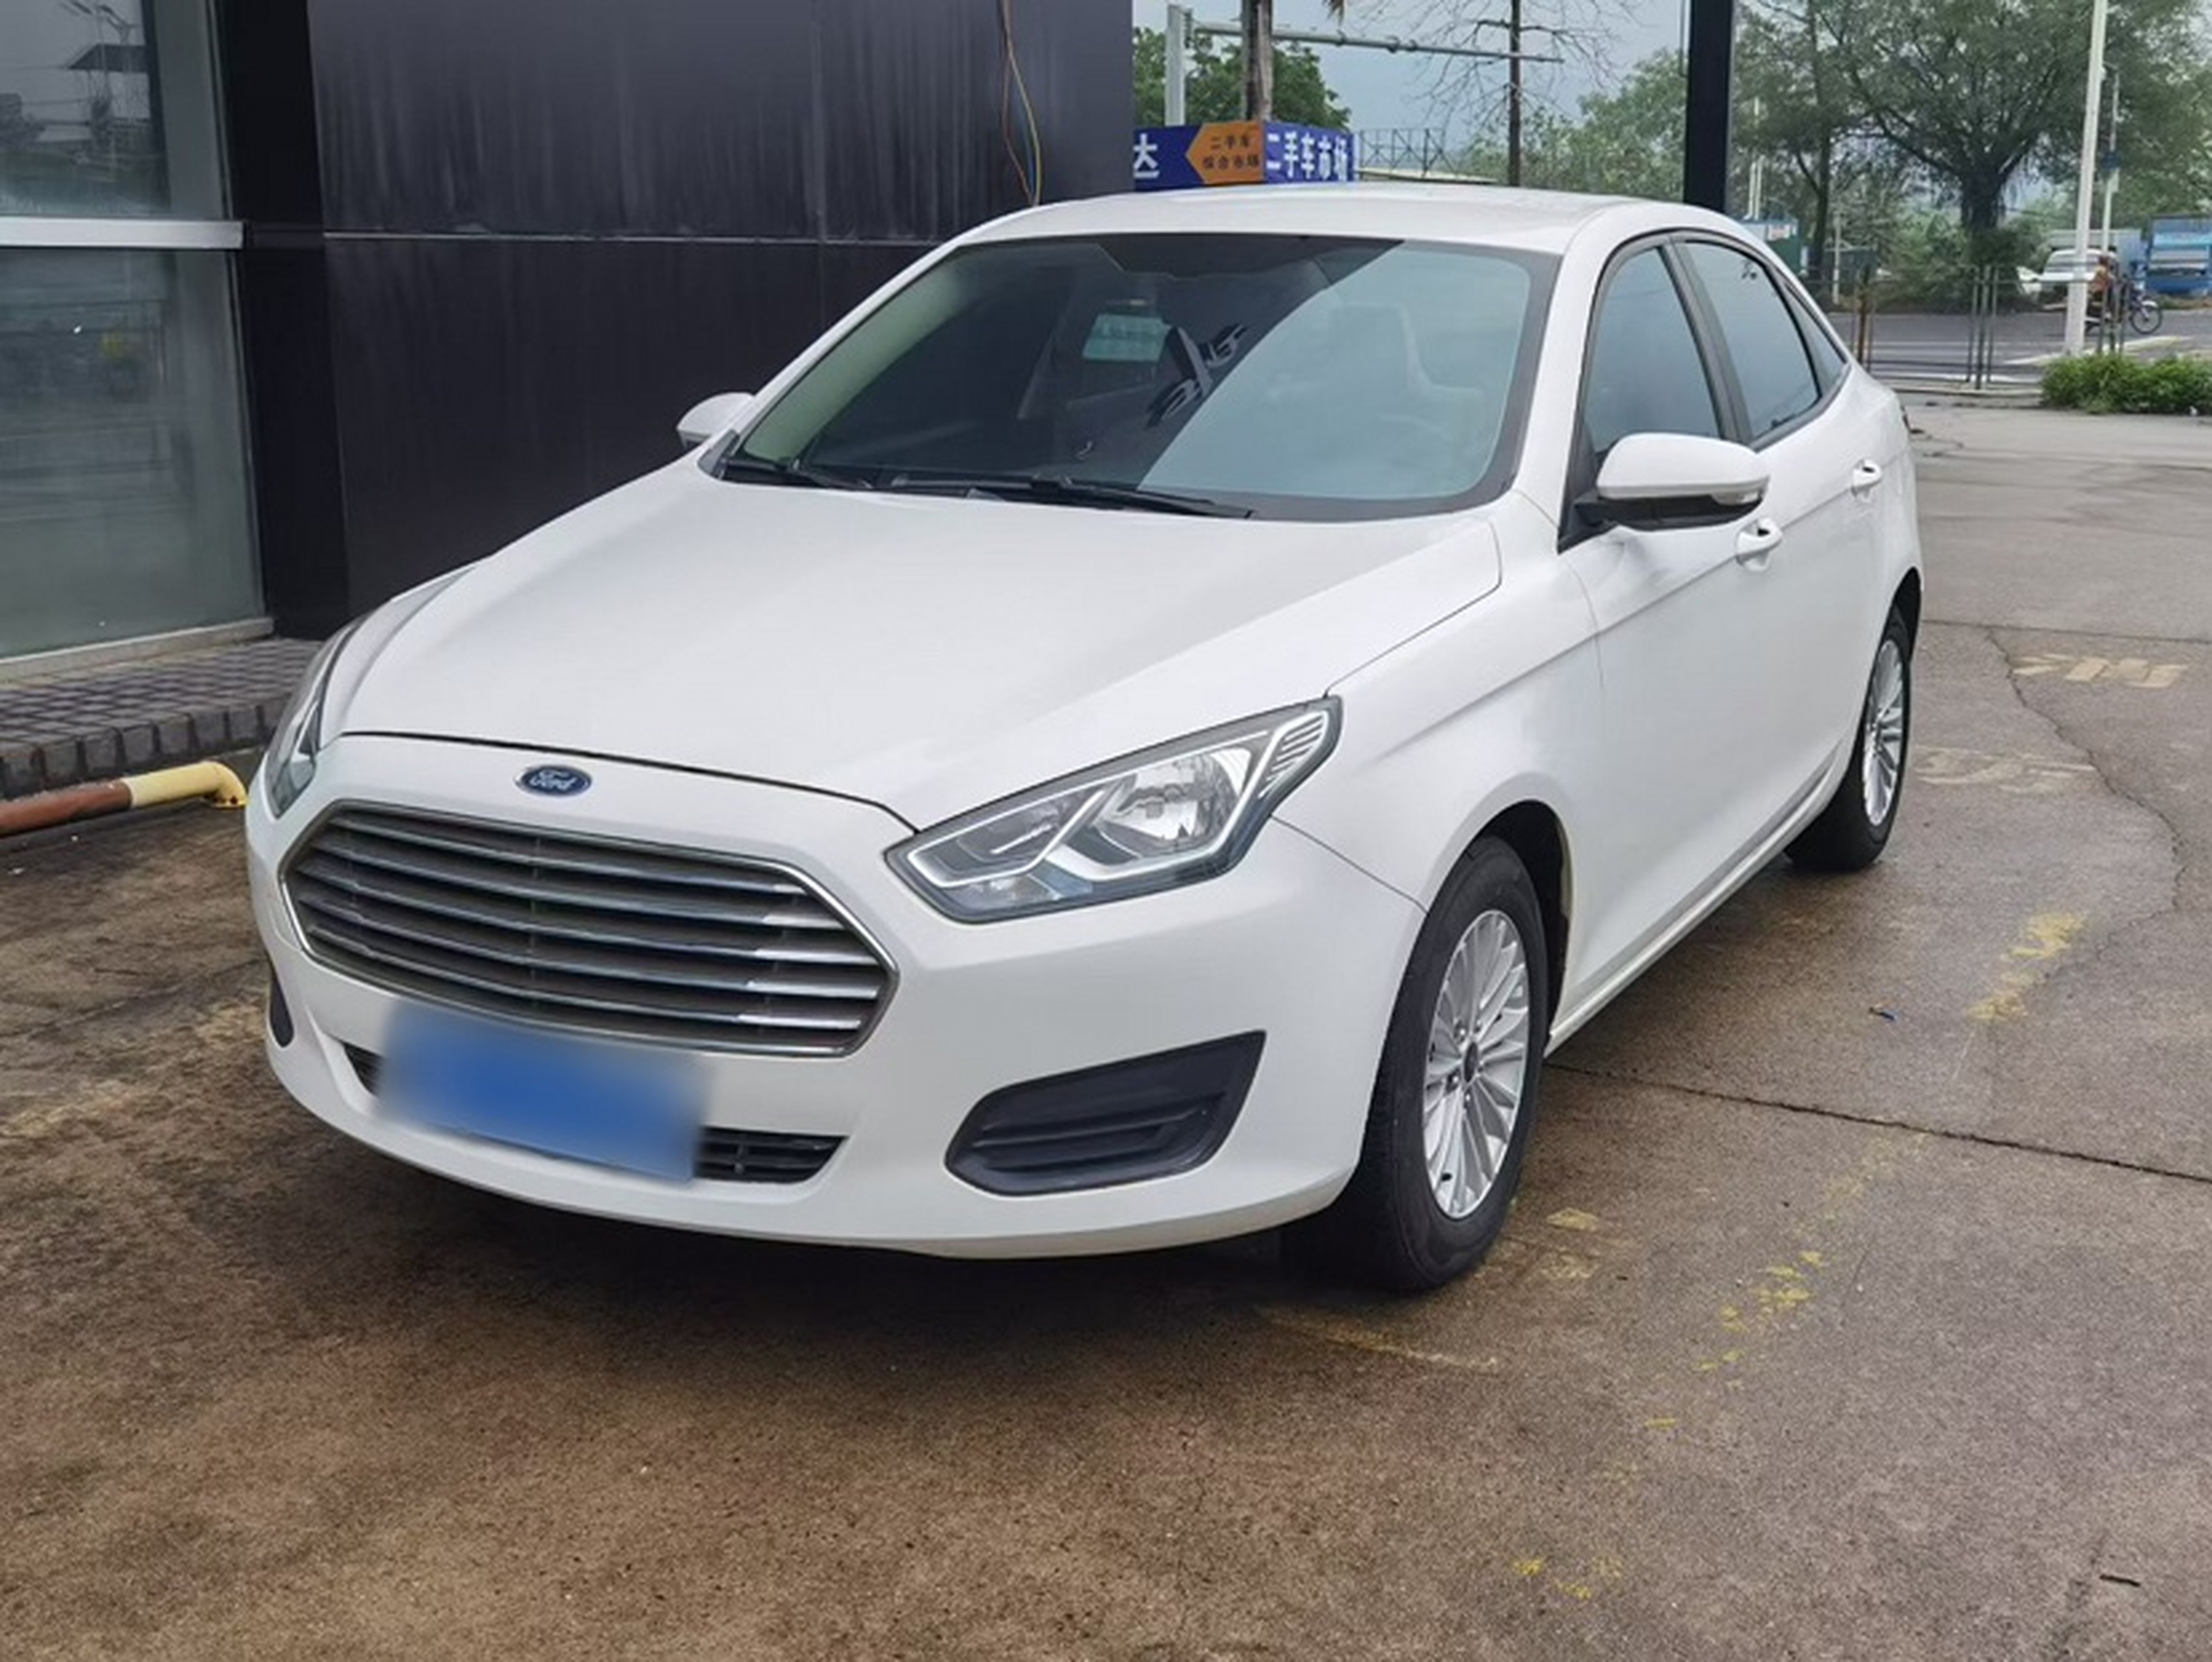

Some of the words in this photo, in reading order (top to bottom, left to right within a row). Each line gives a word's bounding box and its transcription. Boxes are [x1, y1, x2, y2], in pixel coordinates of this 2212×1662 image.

[1266, 131, 1348, 181] 二手车市场
[529, 770, 577, 790] Ford
